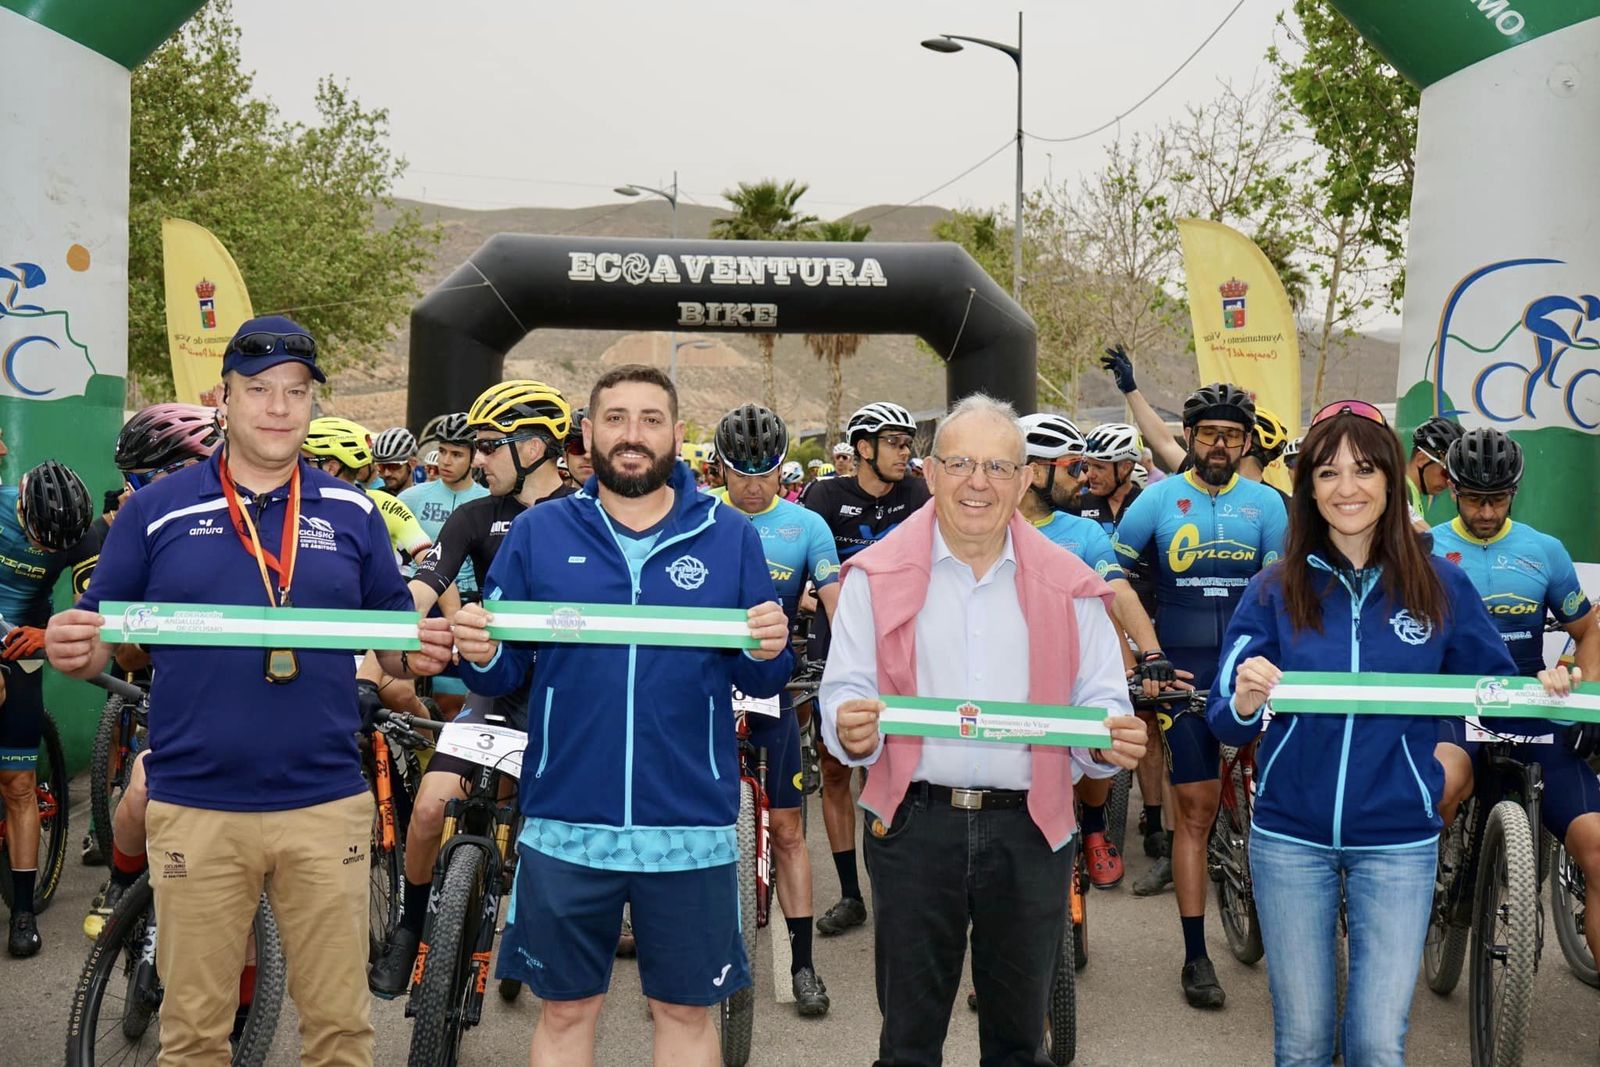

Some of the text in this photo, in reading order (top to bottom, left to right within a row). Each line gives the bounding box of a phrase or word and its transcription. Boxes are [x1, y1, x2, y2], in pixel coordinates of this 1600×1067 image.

[568, 251, 888, 287] ECOAVENTURA
[677, 301, 778, 328] BIKE
[189, 527, 224, 536] amura
[299, 529, 335, 540] CICLISMO
[476, 733, 495, 751] 3
[342, 854, 365, 865] amura
[72, 945, 104, 1037] GROUND CONTROL
